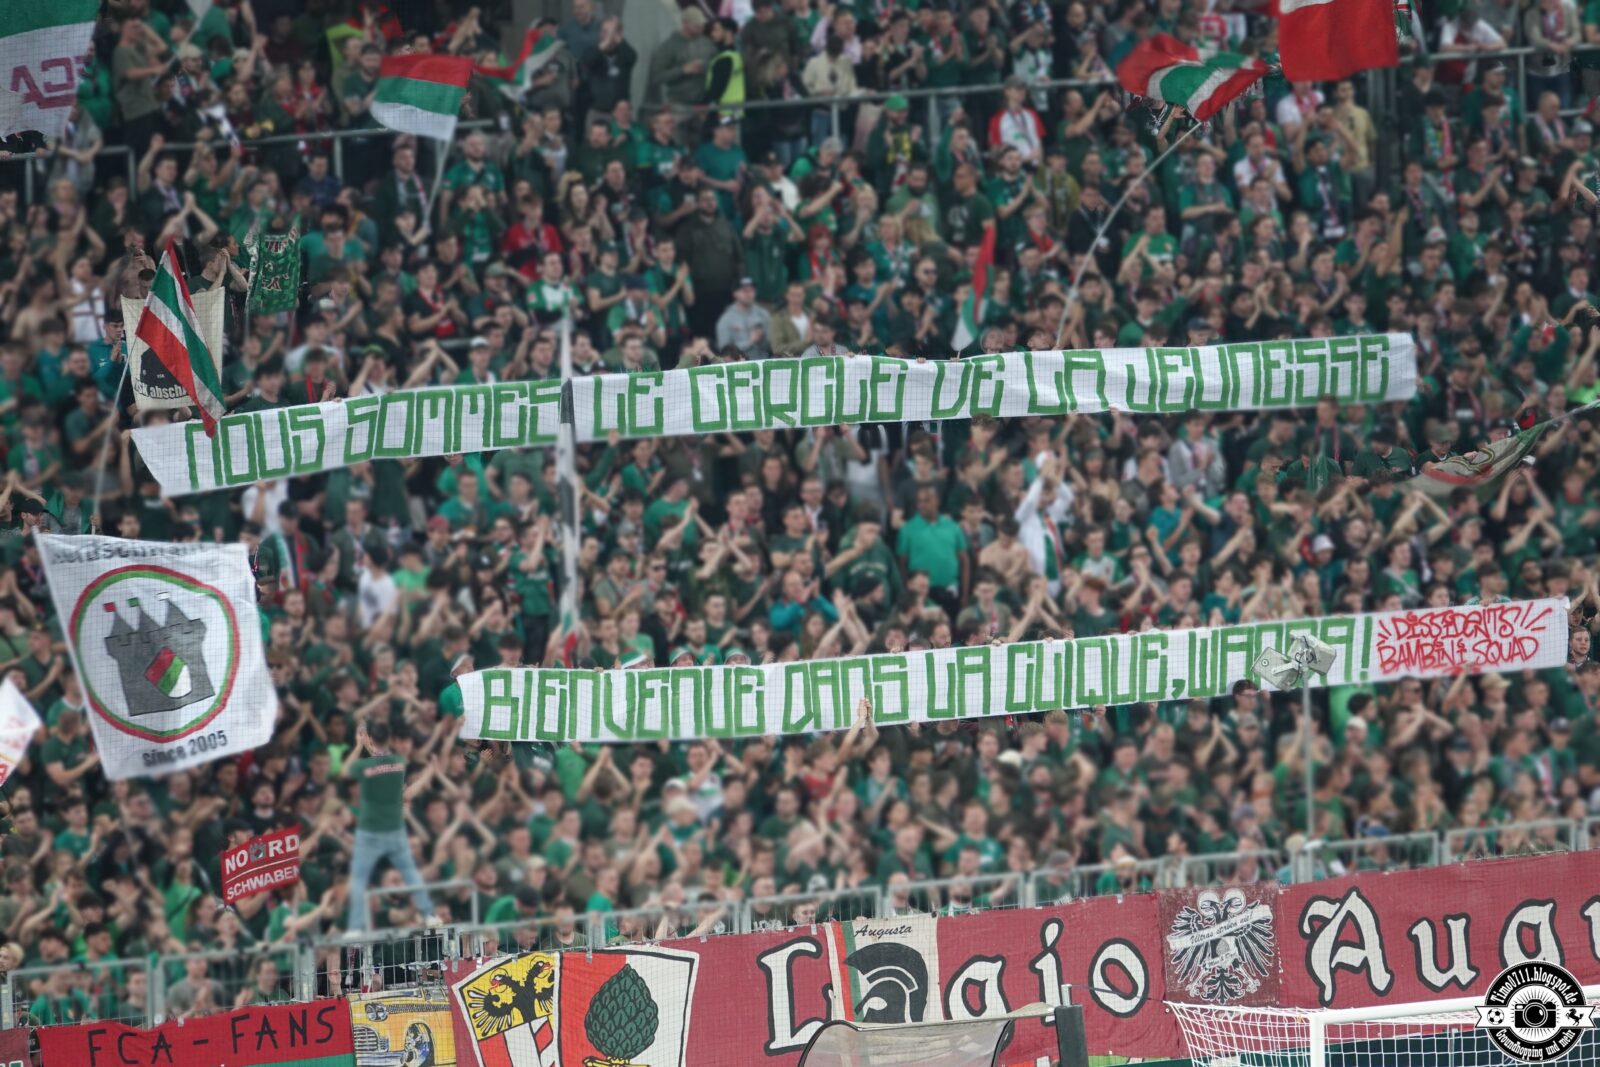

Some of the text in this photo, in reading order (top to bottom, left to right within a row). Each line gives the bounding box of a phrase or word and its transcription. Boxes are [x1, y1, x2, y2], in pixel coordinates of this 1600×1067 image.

[185, 406, 326, 490] NOUS
[343, 379, 562, 463] SOMMES
[593, 372, 664, 437] LE
[689, 356, 908, 432] CERCLE
[1024, 350, 1108, 413] LA
[1125, 335, 1389, 412] JEUNESSE
[1471, 637, 1540, 668] SQUAD
[479, 666, 765, 740] BIENVENUE
[782, 656, 909, 733] DANS
[926, 646, 991, 718] LA
[189, 730, 229, 756] 2005
[854, 924, 912, 940] Augusta
[230, 1005, 337, 1055] FANS
